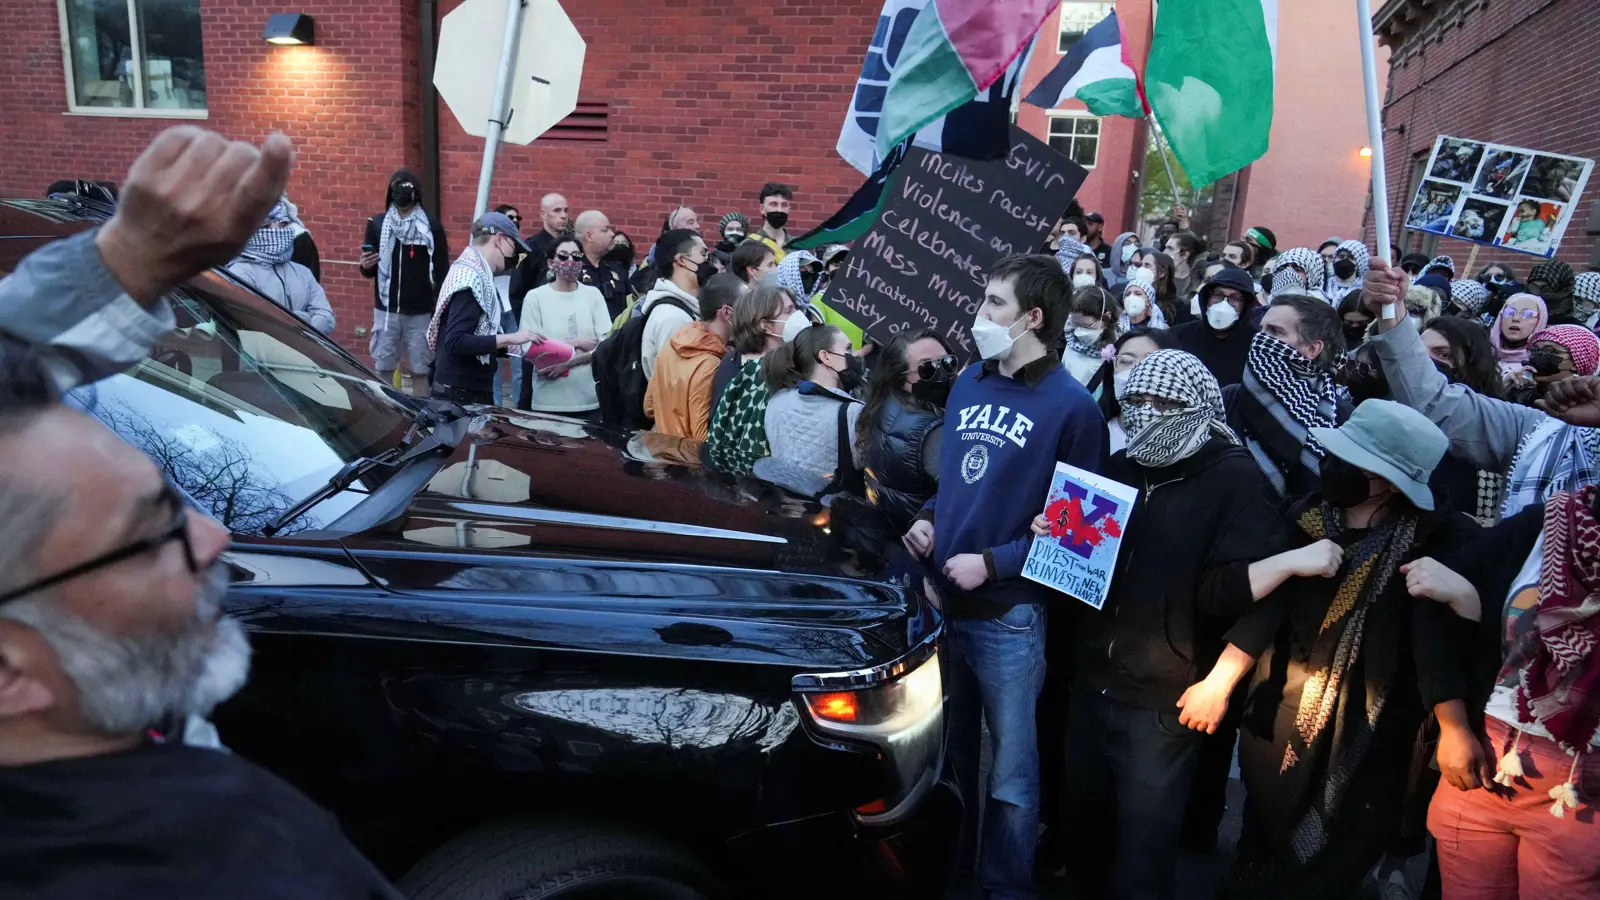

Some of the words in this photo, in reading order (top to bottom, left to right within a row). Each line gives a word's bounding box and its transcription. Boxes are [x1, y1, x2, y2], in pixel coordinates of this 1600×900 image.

[902, 176, 985, 242] Violence
[989, 189, 1051, 232] racist
[845, 256, 938, 329] threatening
[956, 404, 1034, 448] YALE
[961, 432, 1006, 448] UNIVERSITY
[1026, 557, 1079, 590] REINVEST
[1081, 577, 1105, 594] NEW
[1034, 541, 1079, 570] DIVEST
[1087, 564, 1106, 582] WAR
[1074, 587, 1103, 606] HAVEN
